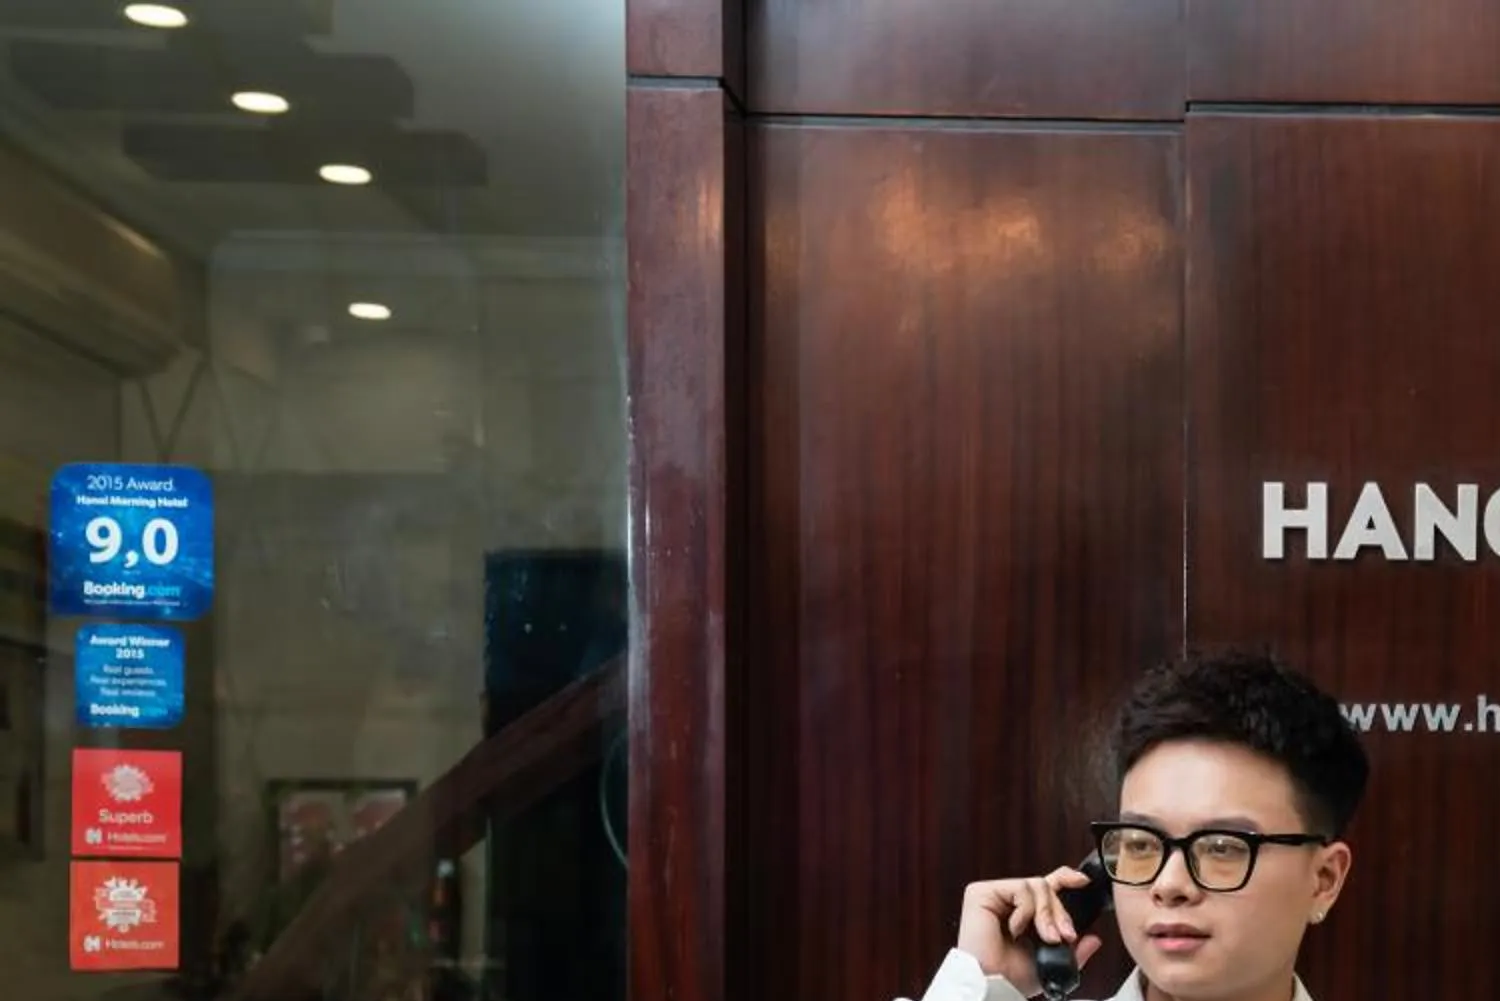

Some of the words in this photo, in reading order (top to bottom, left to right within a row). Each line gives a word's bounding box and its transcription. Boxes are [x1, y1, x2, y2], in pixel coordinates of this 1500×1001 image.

[86, 474, 124, 491] 2015
[109, 495, 157, 509] Morning
[157, 496, 189, 508] Hotel
[85, 516, 179, 568] 9,0
[83, 579, 181, 600] Booking.com
[98, 807, 154, 826] Superb
[105, 937, 165, 951] Hotels.com
